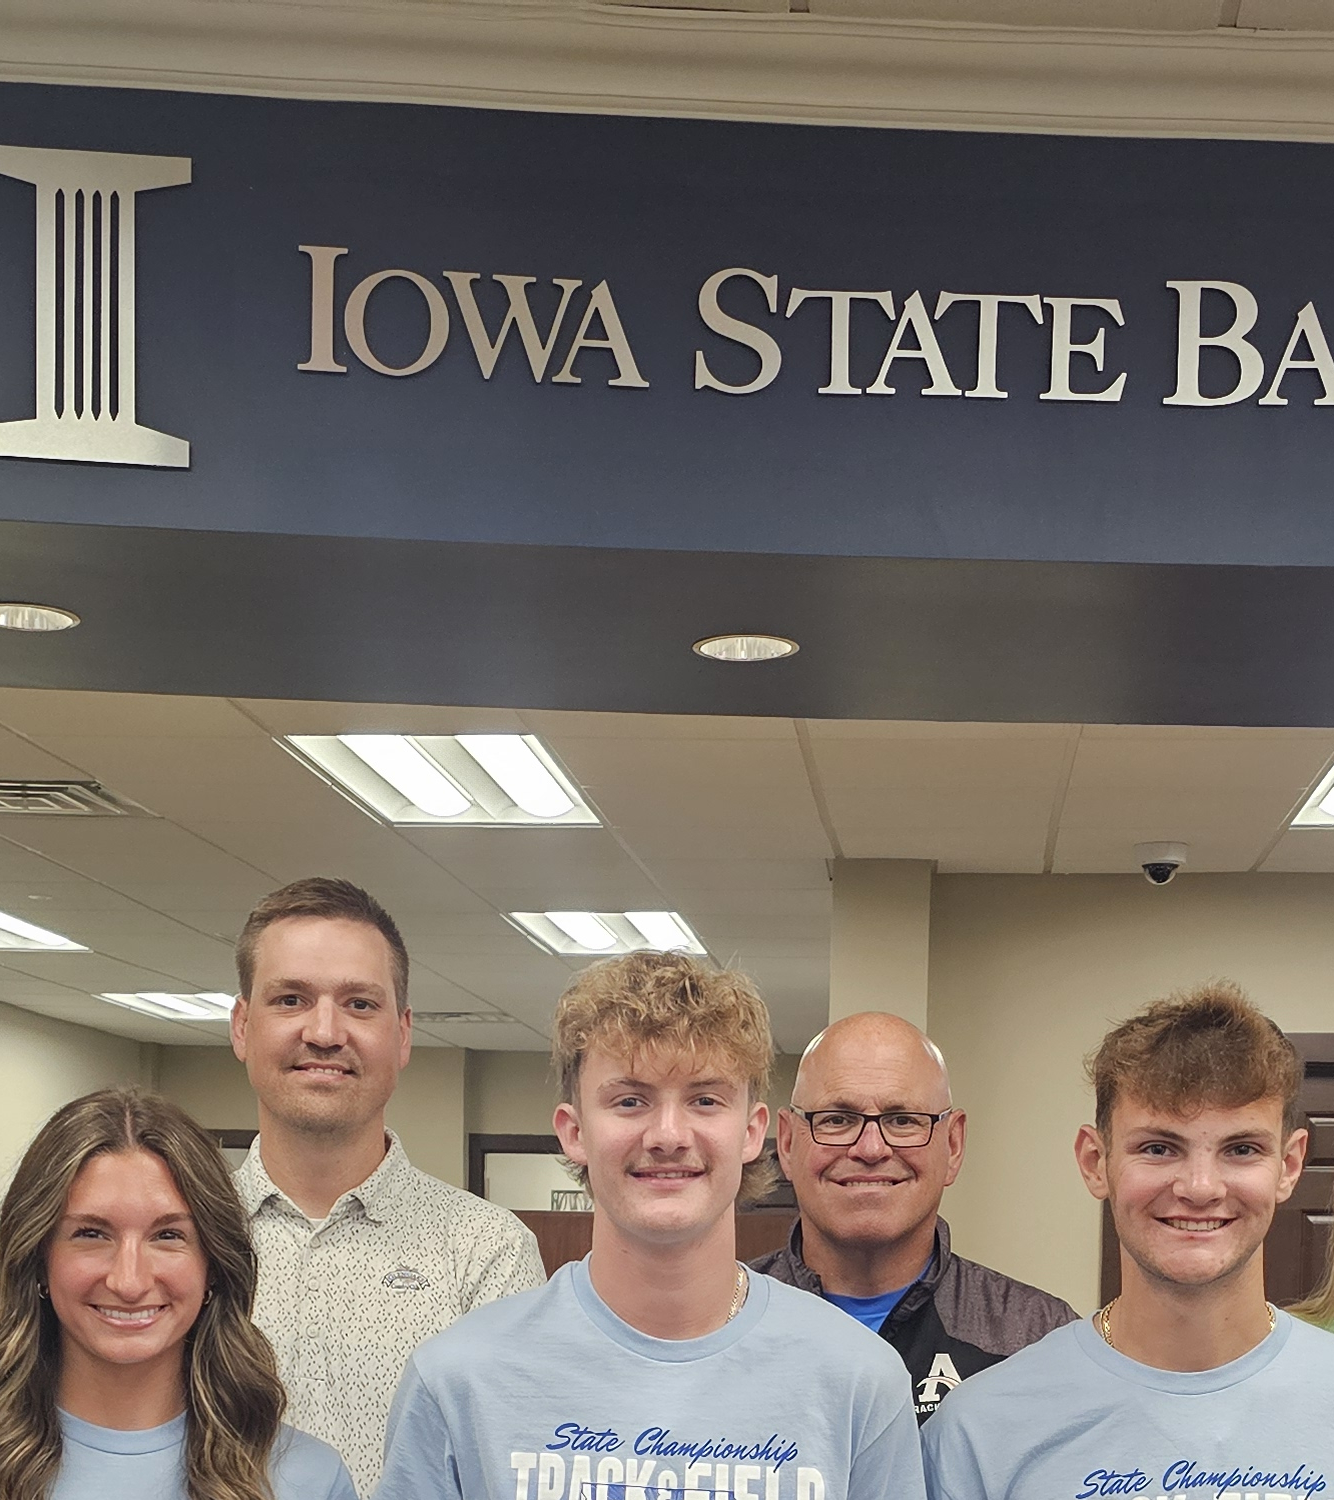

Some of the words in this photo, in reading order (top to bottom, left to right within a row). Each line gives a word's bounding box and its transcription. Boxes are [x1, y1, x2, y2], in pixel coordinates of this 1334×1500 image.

[297, 244, 650, 389] IOWA
[693, 266, 1128, 404] STATE
[914, 1403, 942, 1414] RACK
[546, 1422, 626, 1454] State
[634, 1426, 798, 1474] Championship
[1075, 1468, 1153, 1499] State
